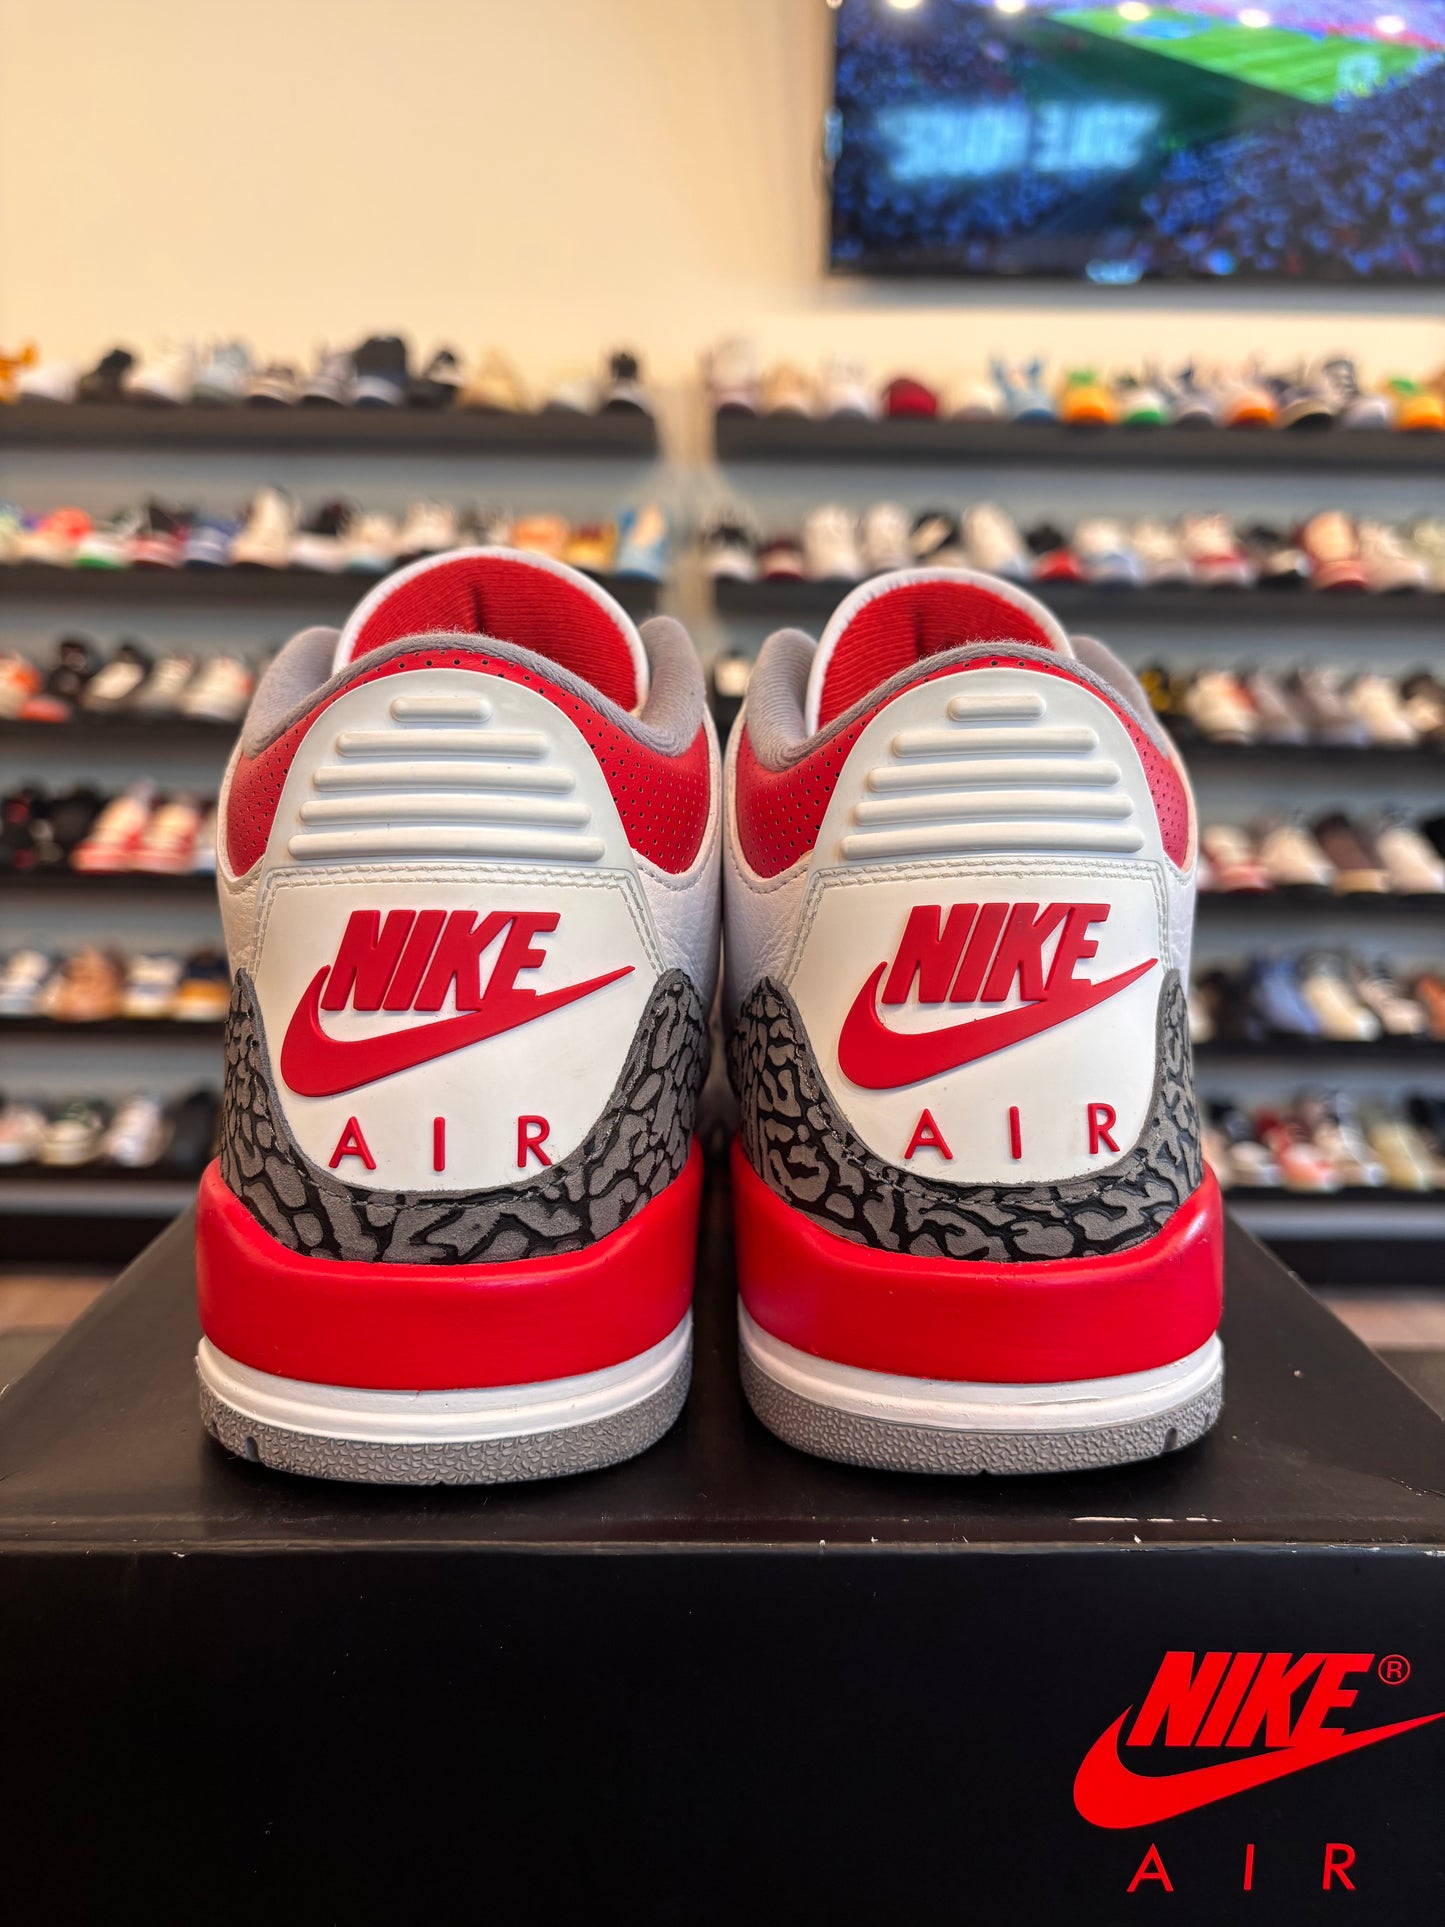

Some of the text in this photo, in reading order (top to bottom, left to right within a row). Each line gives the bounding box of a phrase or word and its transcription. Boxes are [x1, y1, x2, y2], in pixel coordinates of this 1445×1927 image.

[320, 910, 561, 1012] NIKE
[881, 903, 1111, 1004] NIKE
[329, 1115, 552, 1172] AIR
[904, 1103, 1120, 1160] AIR
[1126, 1843, 1357, 1892] AIR
